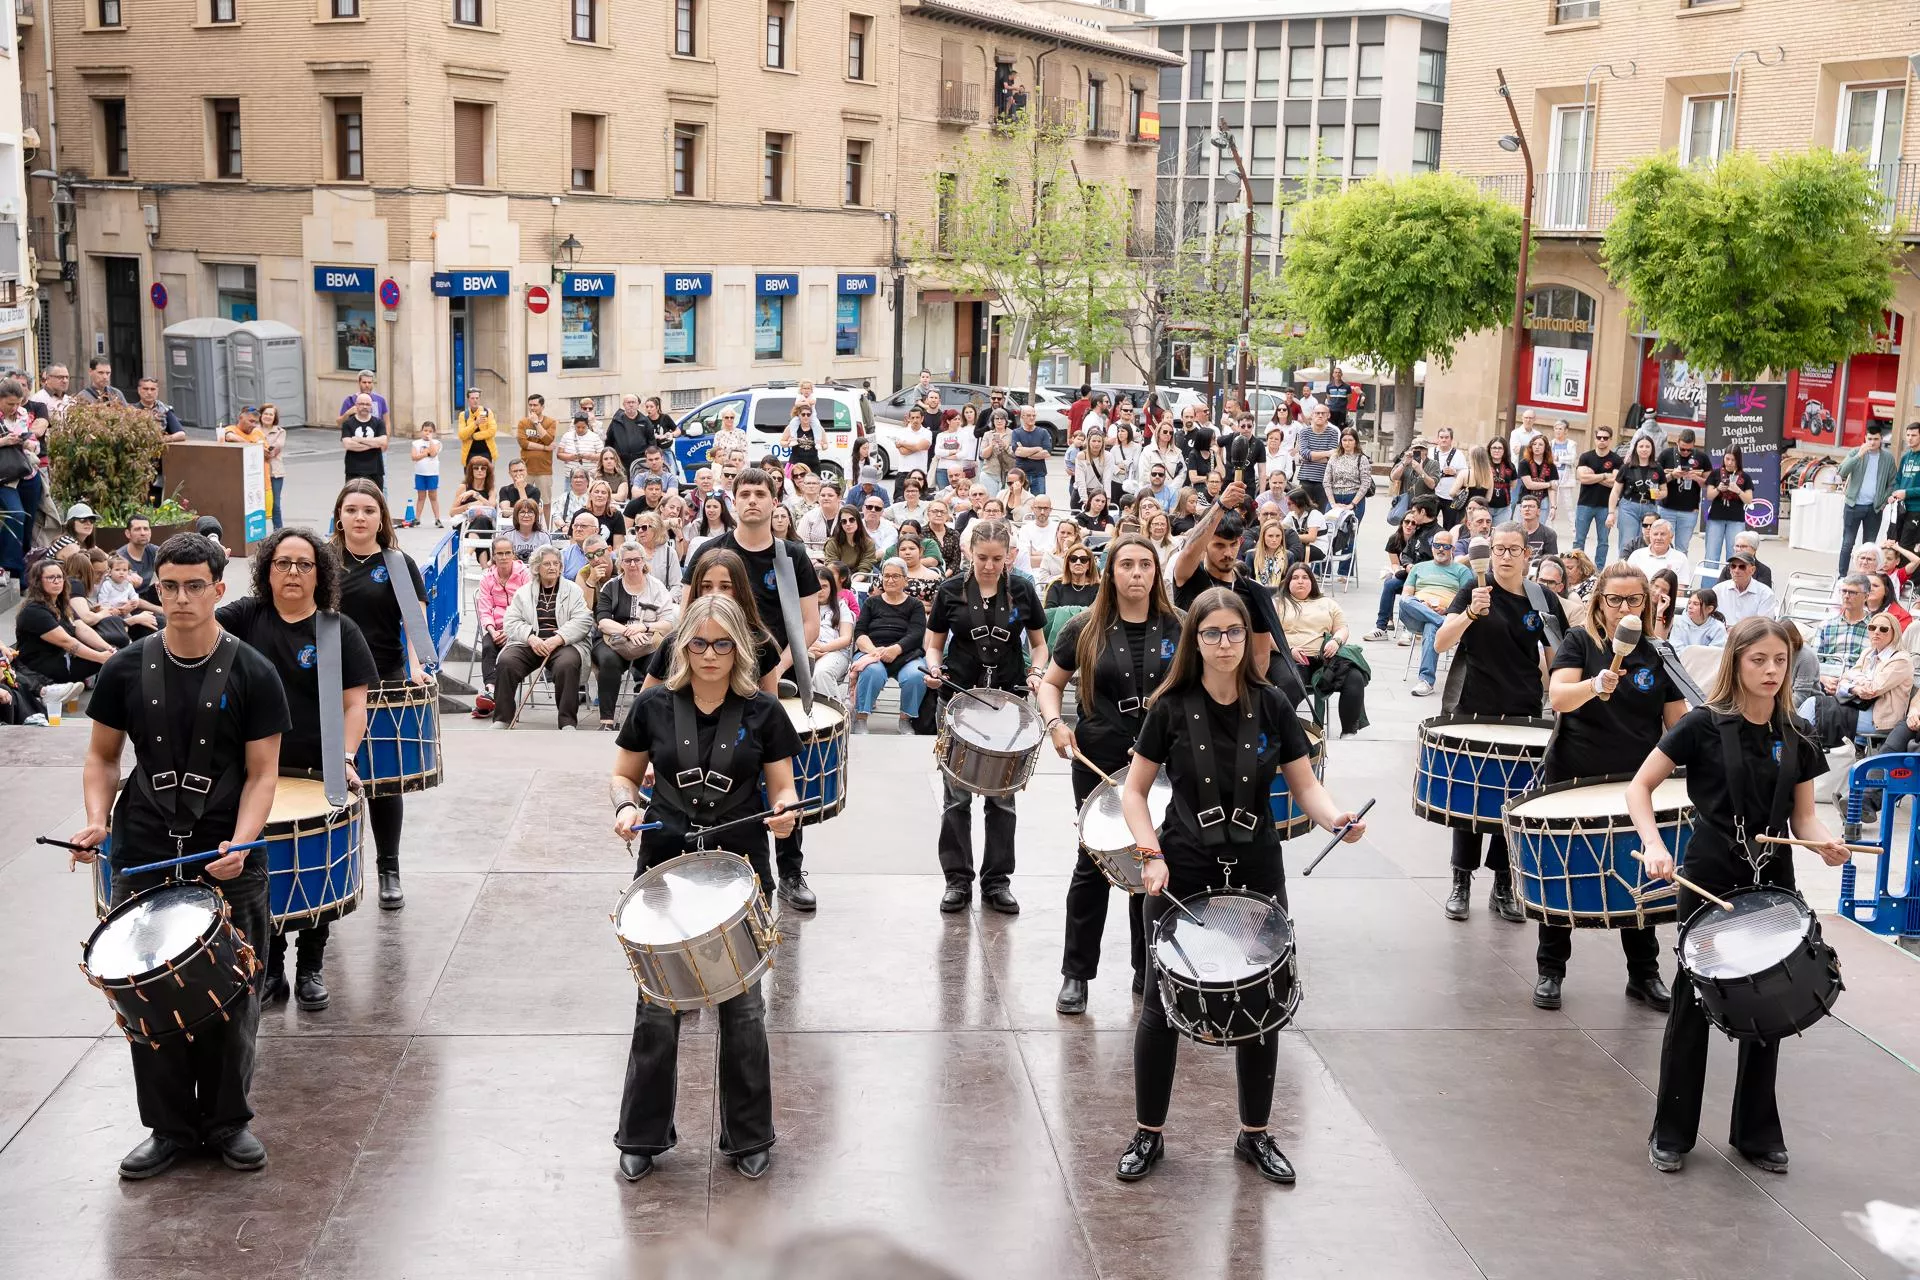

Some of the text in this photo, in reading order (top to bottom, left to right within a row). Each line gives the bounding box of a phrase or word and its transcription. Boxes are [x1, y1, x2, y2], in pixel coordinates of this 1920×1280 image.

[128, 270, 135, 282] 2
[326, 272, 360, 287] BBVA
[463, 275, 497, 291] BBVA
[574, 278, 604, 292] BBVA
[675, 277, 702, 291] BBVA
[765, 278, 790, 291] BBVA
[846, 278, 868, 291] BBVA
[531, 359, 546, 367] BBVA
[1724, 414, 1763, 422] detambores.es
[1722, 425, 1763, 437] Regalos
[1731, 436, 1755, 445] para
[771, 444, 792, 457] 09
[1711, 443, 1777, 456] tarileros
